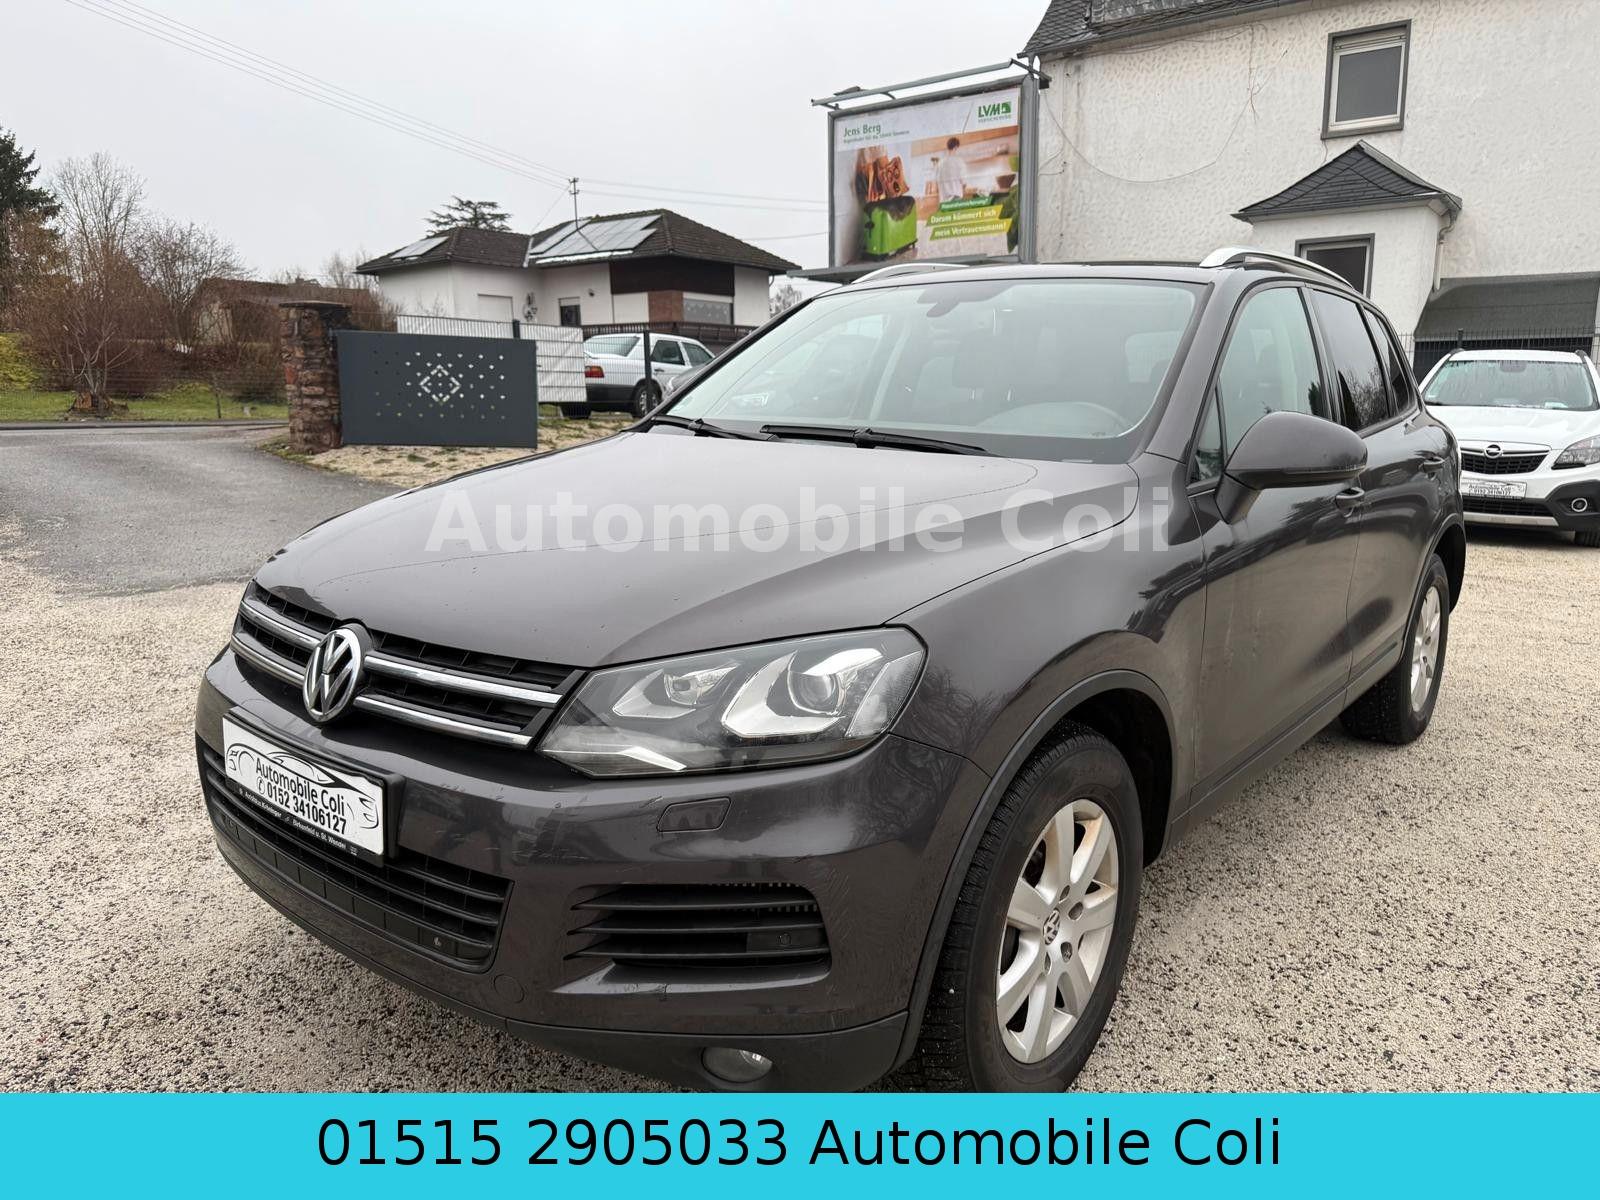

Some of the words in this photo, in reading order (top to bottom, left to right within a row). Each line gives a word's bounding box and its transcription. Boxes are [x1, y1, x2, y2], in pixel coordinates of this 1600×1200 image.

[978, 102, 1000, 118] LVM
[843, 127, 861, 138] Jens
[863, 123, 882, 136] Berg
[930, 214, 953, 224] Darum
[934, 227, 951, 237] mein
[256, 758, 319, 805] Automobile
[321, 790, 345, 816] Coli
[267, 782, 290, 809] 0152
[293, 797, 347, 835] 34106127
